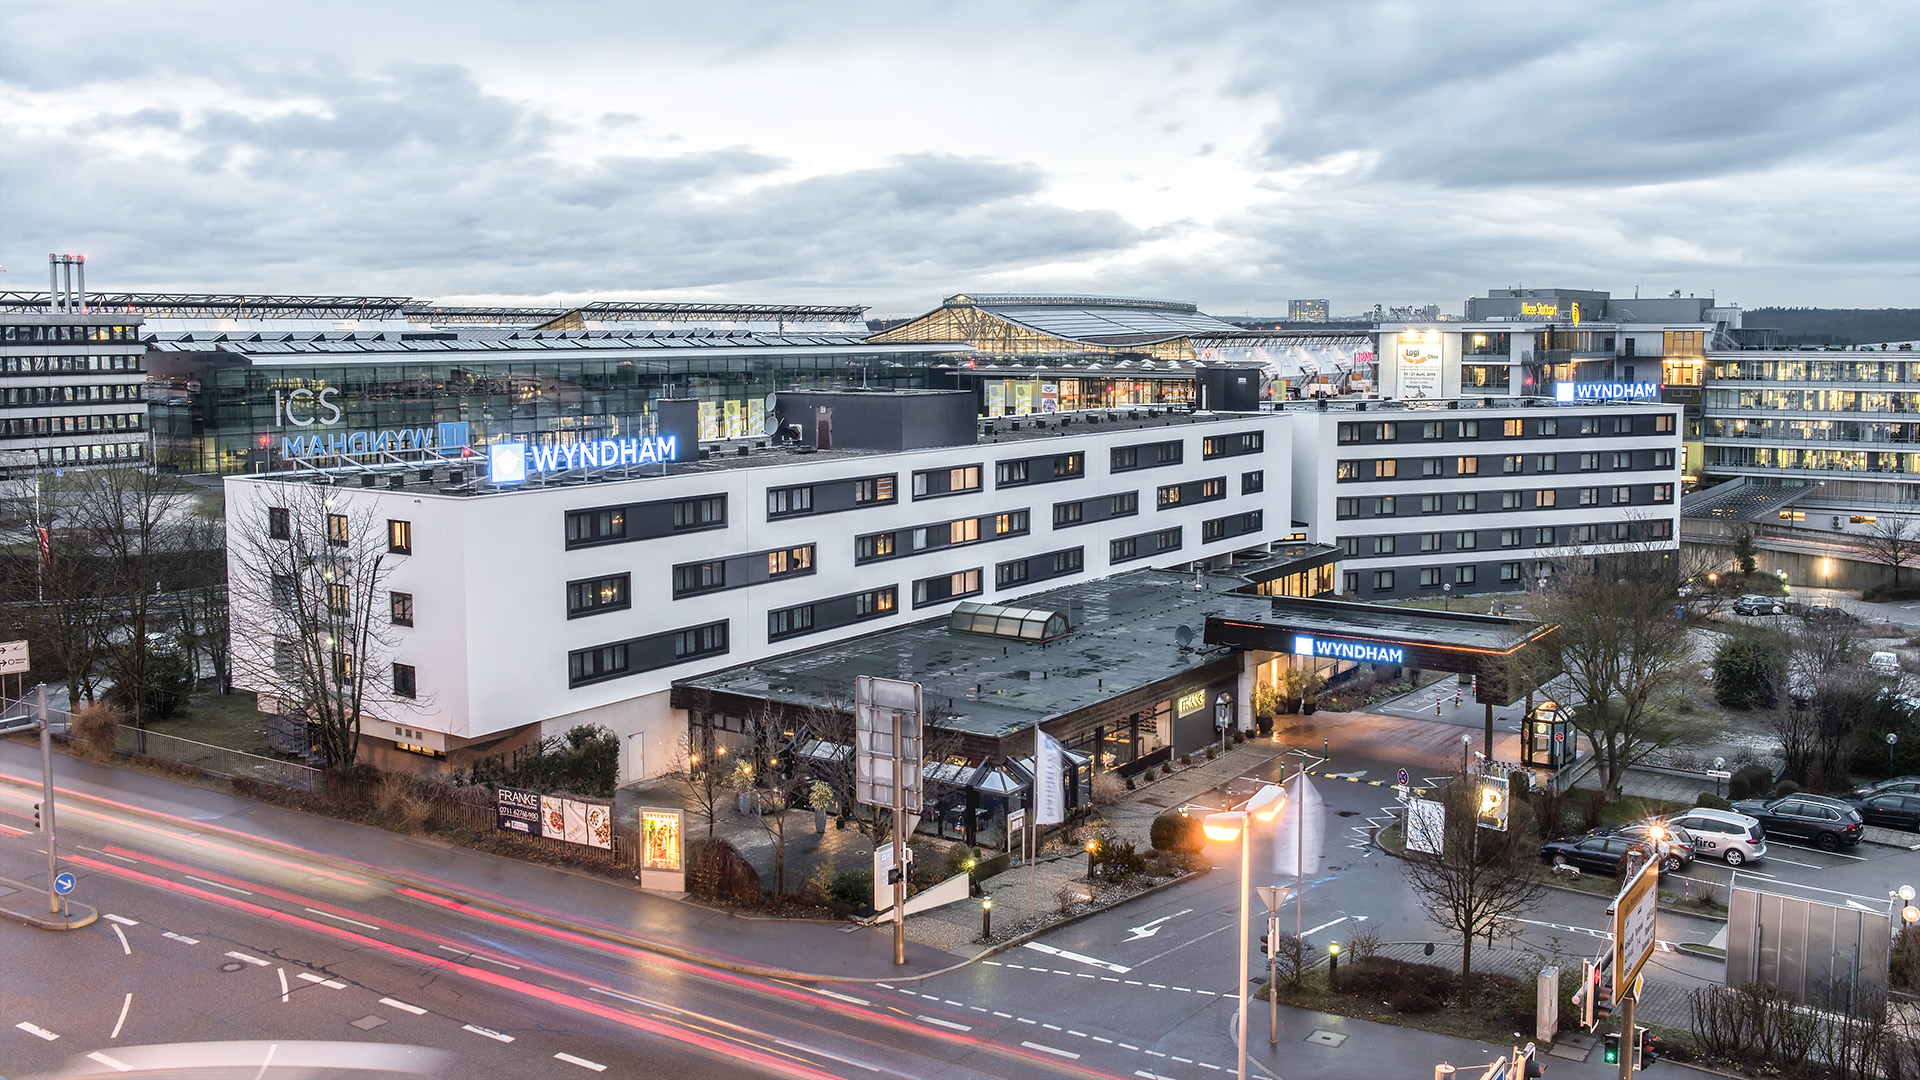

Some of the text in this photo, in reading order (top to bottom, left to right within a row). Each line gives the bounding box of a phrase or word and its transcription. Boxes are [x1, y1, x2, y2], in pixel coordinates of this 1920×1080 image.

[1577, 383, 1656, 398] WYNDHAM
[275, 387, 340, 426] ICS
[531, 436, 676, 473] WYNDHAM
[1317, 641, 1403, 663] WYNDHAM
[498, 789, 538, 807] FRANKE
